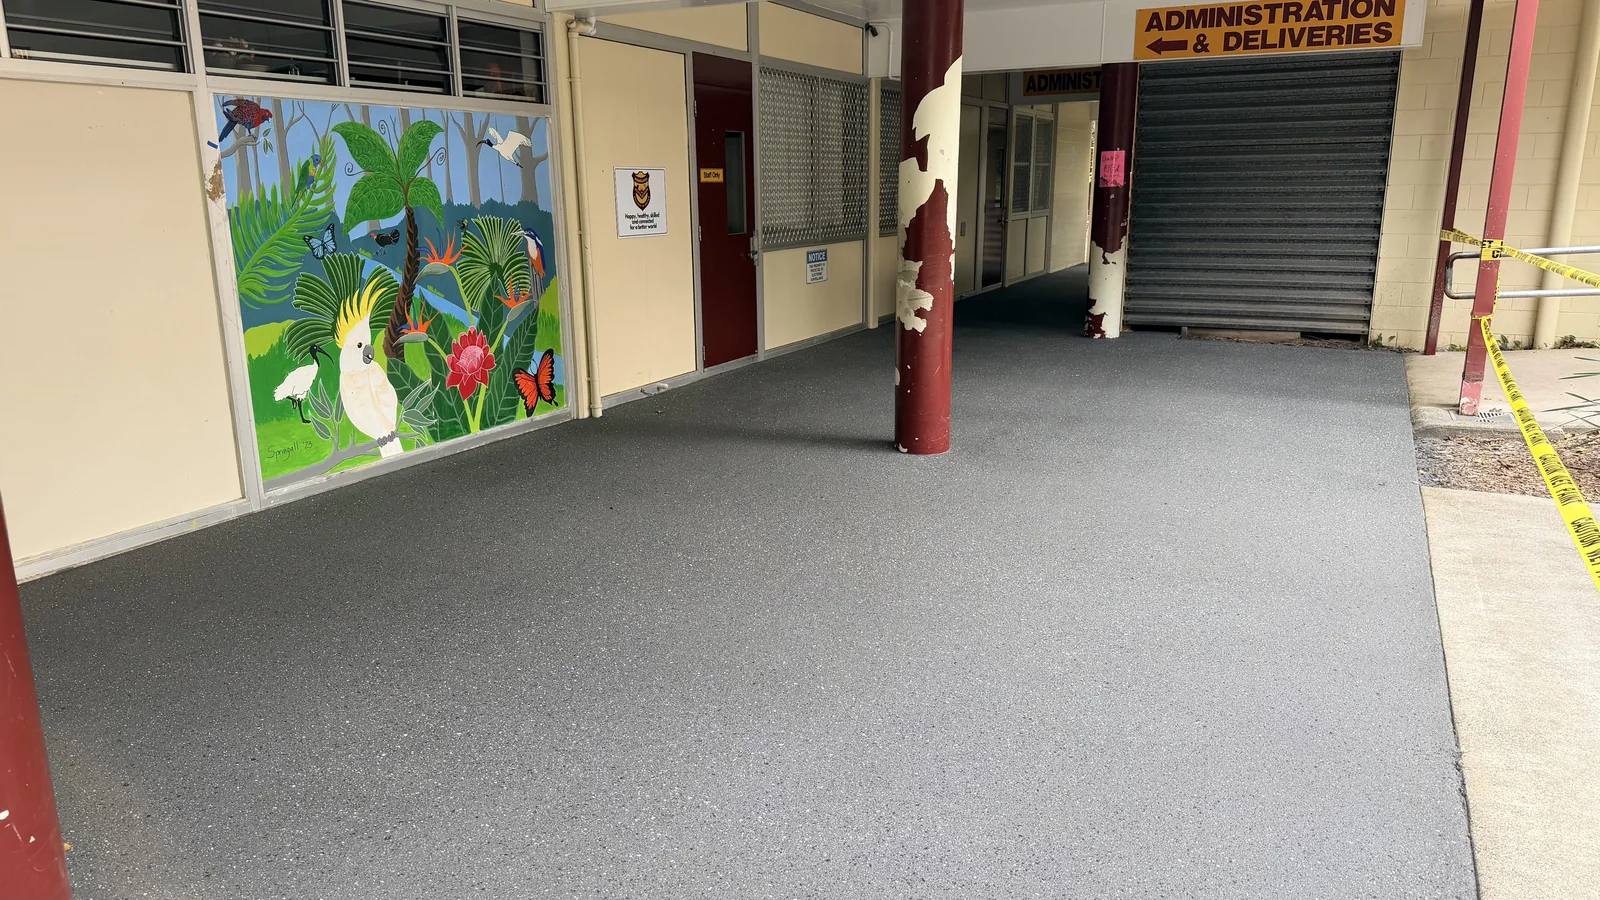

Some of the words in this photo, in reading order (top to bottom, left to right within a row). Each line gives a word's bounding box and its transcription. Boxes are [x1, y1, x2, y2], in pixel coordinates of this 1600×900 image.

[1145, 0, 1396, 32] ADMINISTRATION
[1192, 33, 1210, 54] &
[1223, 21, 1393, 52] DELIVERIES
[703, 171, 712, 179] Staff
[712, 171, 720, 180] Only
[808, 251, 826, 262] NOTICE
[1538, 453, 1567, 476] CAUTION
[1549, 474, 1574, 489] WET
[1555, 487, 1584, 506] PAINT
[1570, 516, 1600, 549] CAUTION
